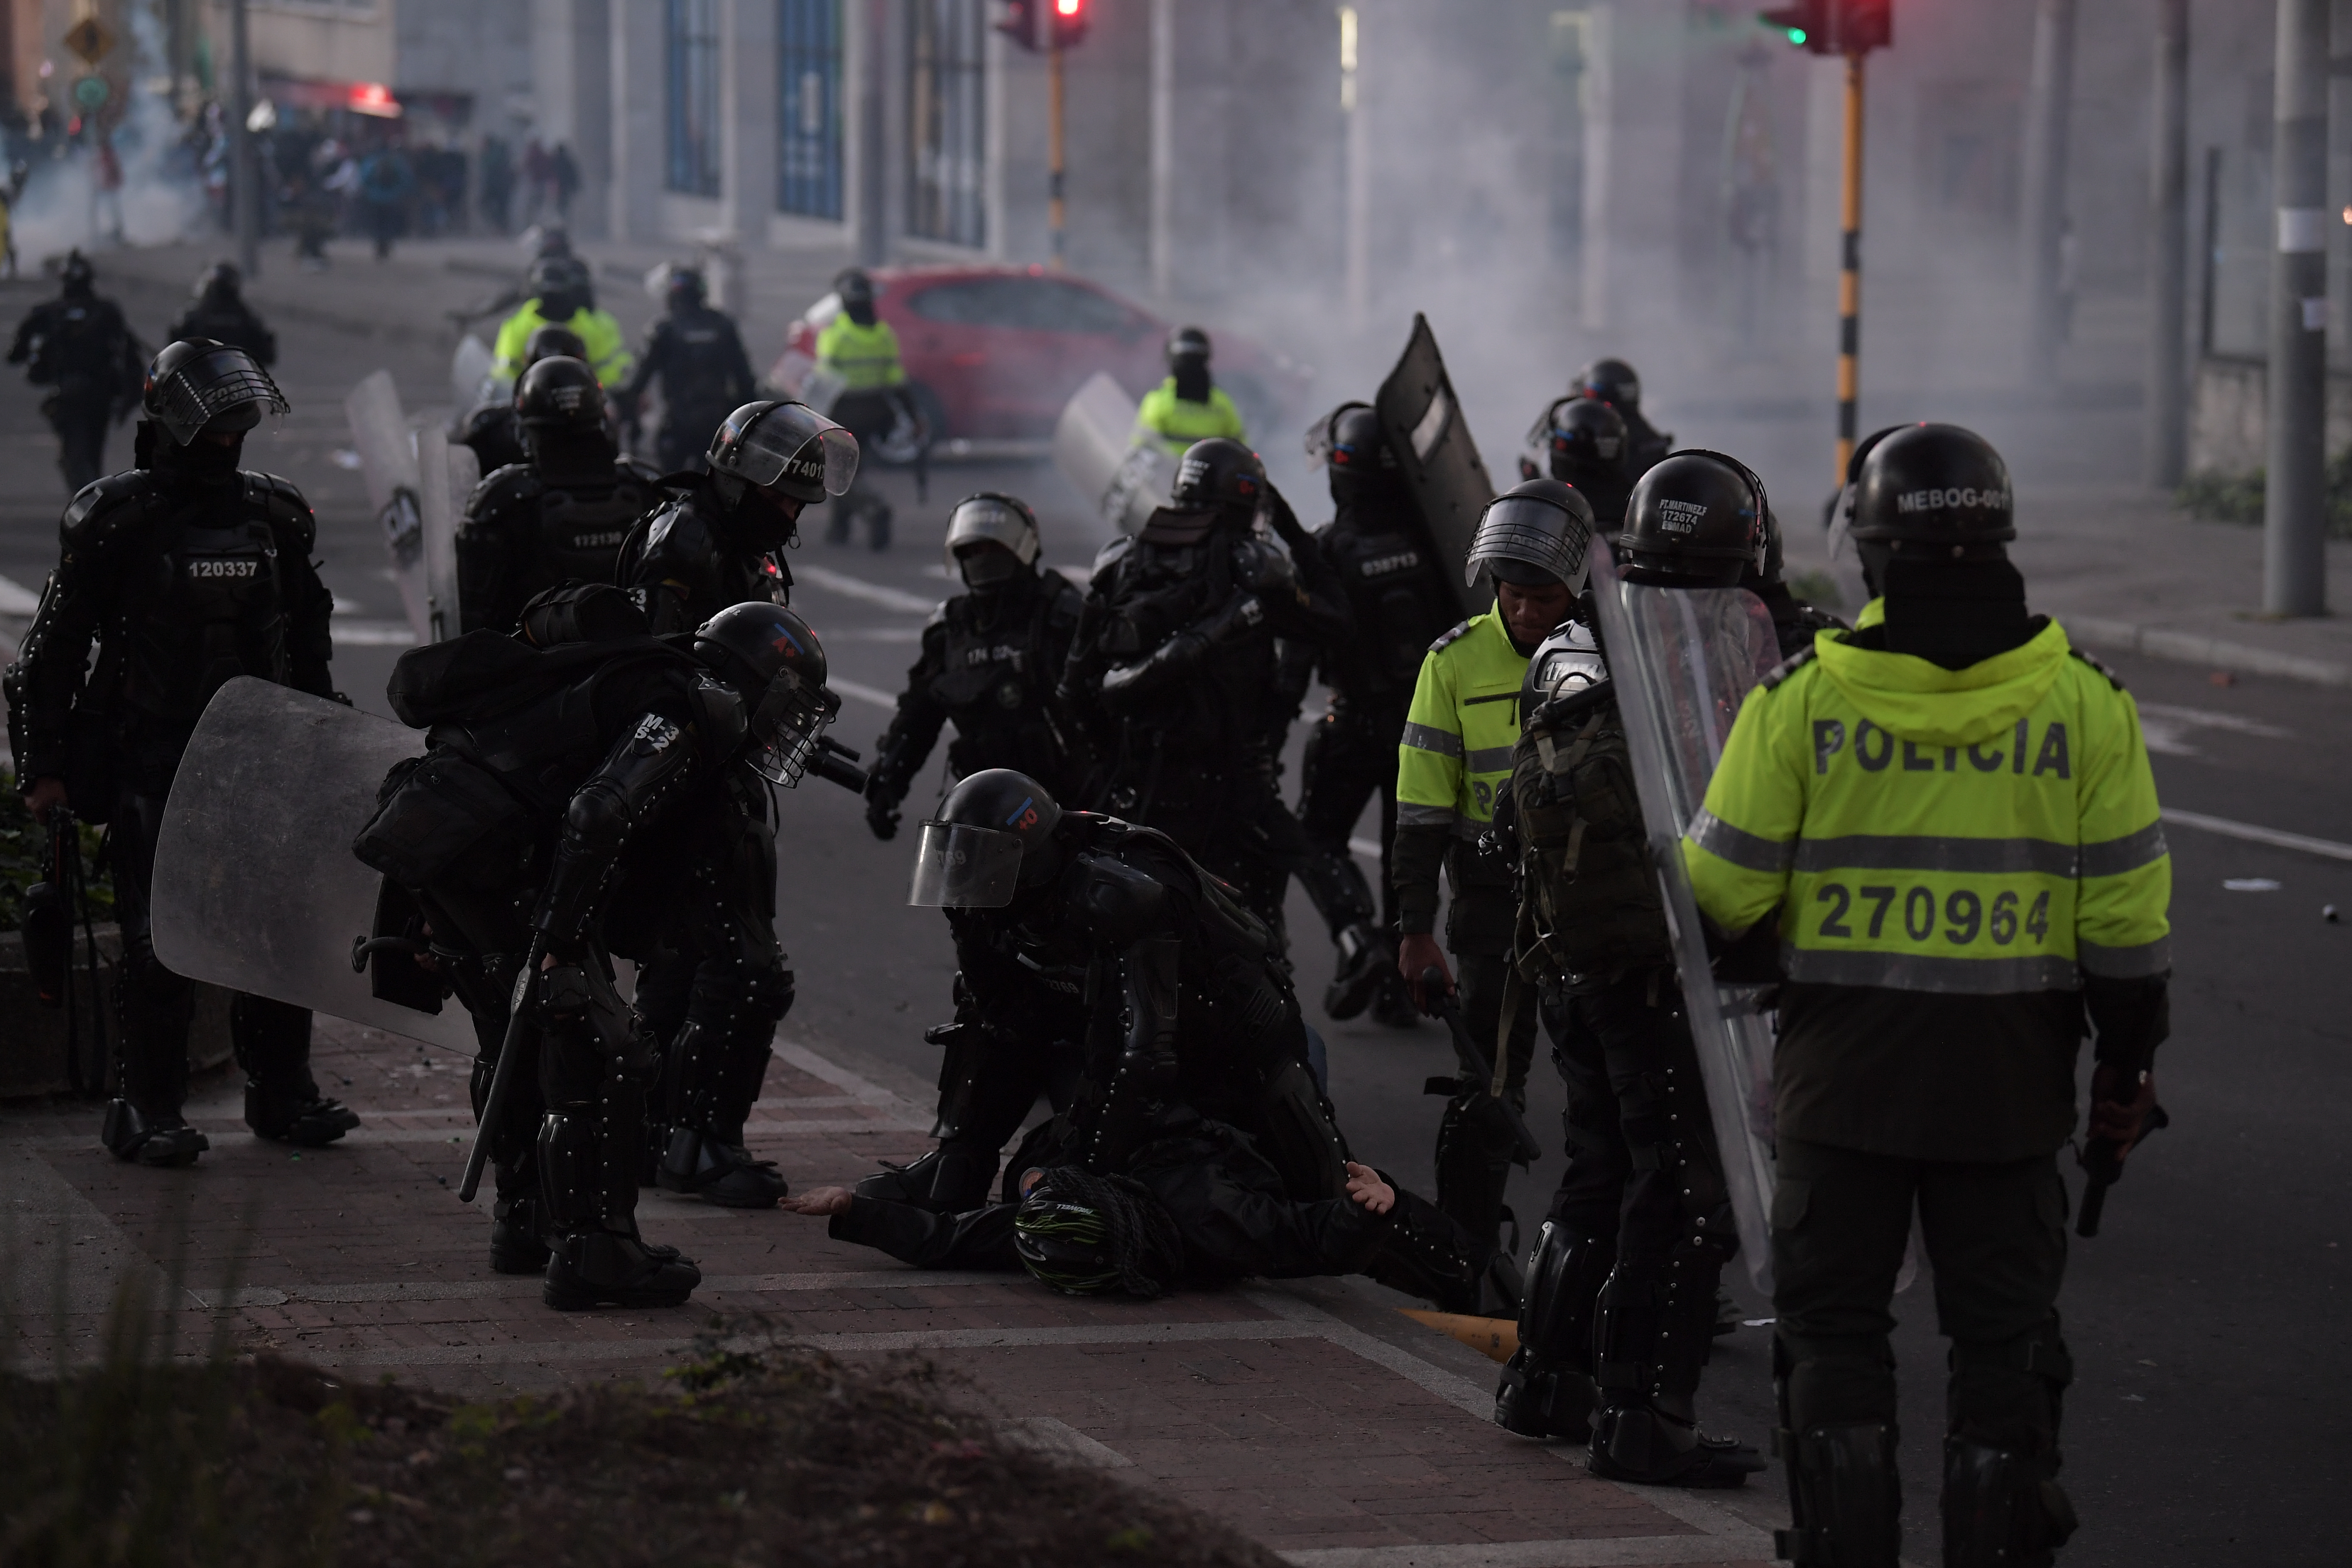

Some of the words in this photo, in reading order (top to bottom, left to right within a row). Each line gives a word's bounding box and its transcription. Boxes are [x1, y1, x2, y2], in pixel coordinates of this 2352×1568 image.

[1662, 510, 1698, 525] 172674
[189, 561, 257, 577] 120337
[1817, 884, 2050, 945] 270964
